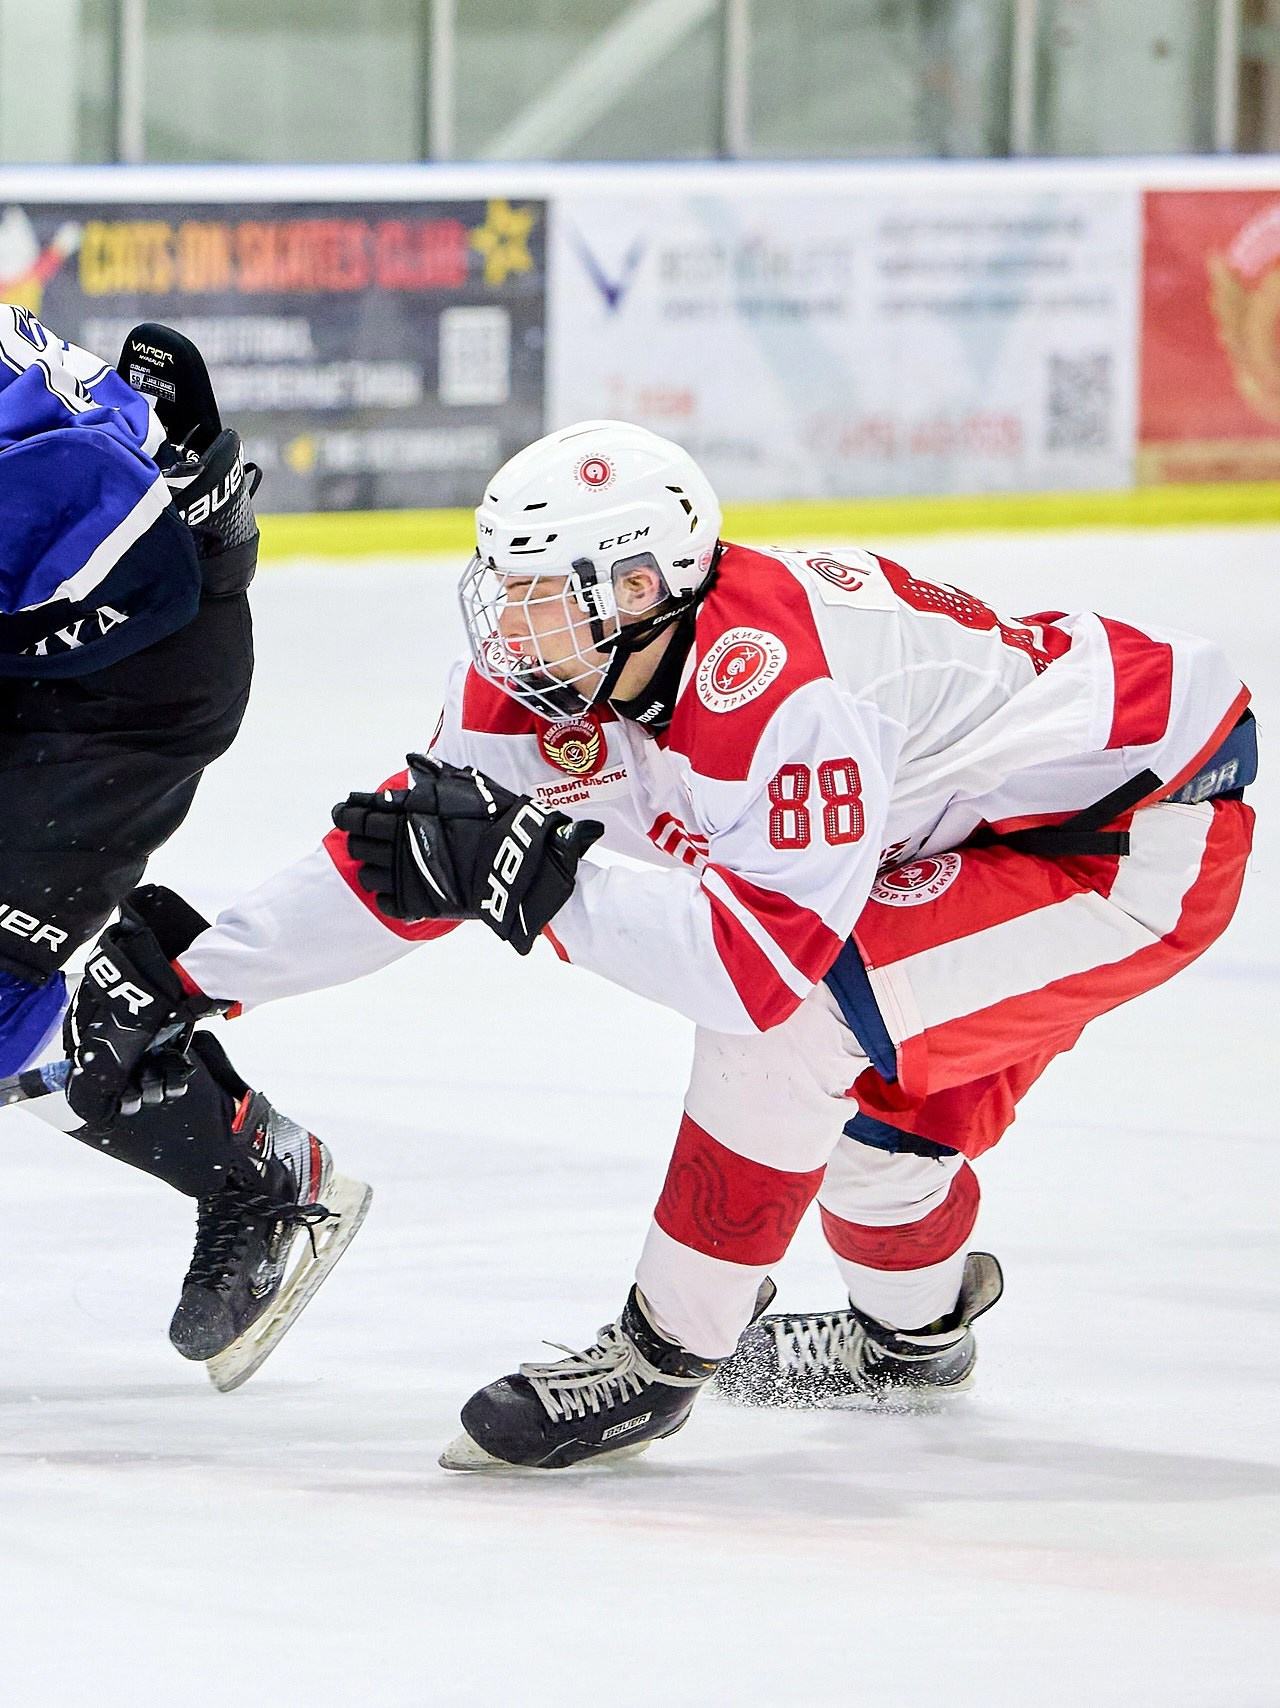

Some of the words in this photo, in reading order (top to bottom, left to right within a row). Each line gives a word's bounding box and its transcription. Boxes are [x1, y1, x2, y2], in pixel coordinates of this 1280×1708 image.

[131, 340, 175, 365] VAPOR
[178, 440, 245, 526] AUE
[479, 523, 494, 537] CM
[598, 526, 651, 551] CCM
[699, 631, 764, 703] МОСКОВСКИЙ
[723, 648, 781, 709] ТРАНСПОРТ
[544, 790, 591, 808] осквы
[768, 757, 866, 850] 88
